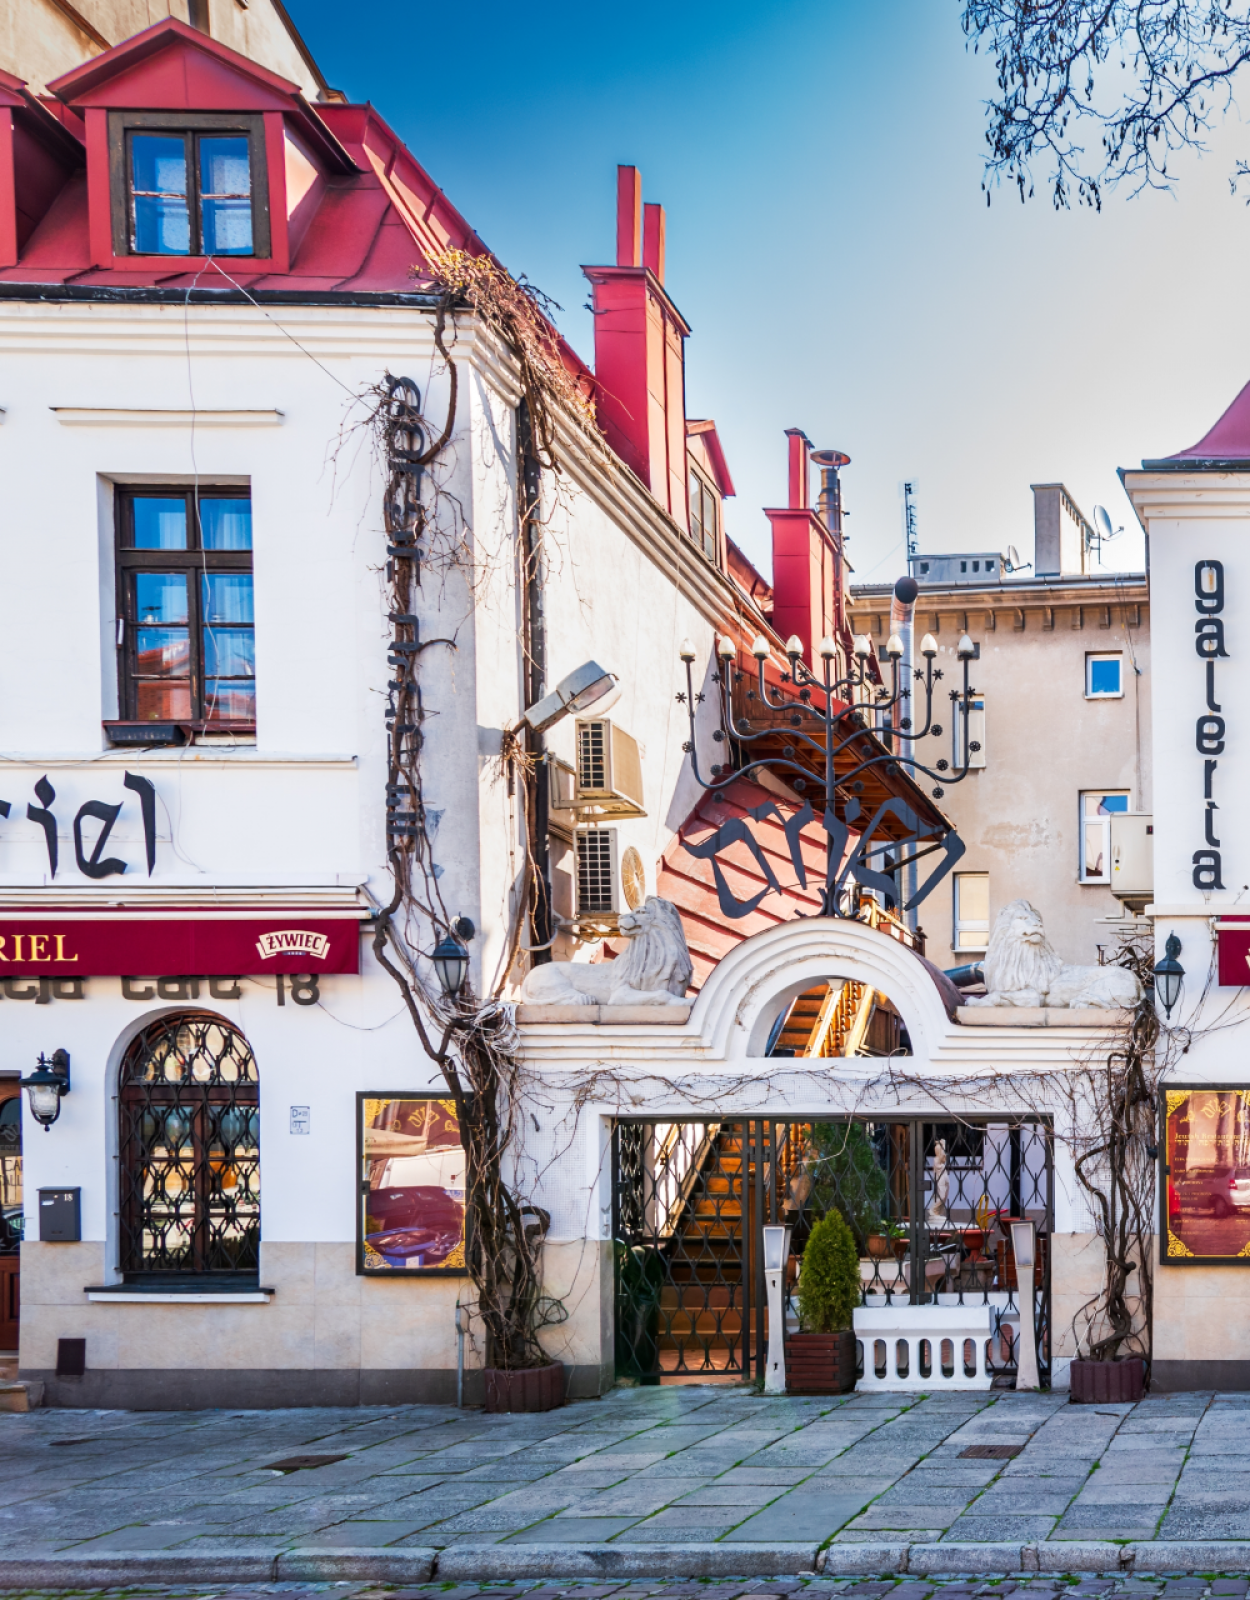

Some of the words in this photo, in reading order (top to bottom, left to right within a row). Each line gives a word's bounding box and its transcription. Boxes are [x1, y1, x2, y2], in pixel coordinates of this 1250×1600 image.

[1192, 560, 1230, 890] galeria
[265, 933, 322, 951] ŻYWIEC
[276, 974, 320, 1006] 18
